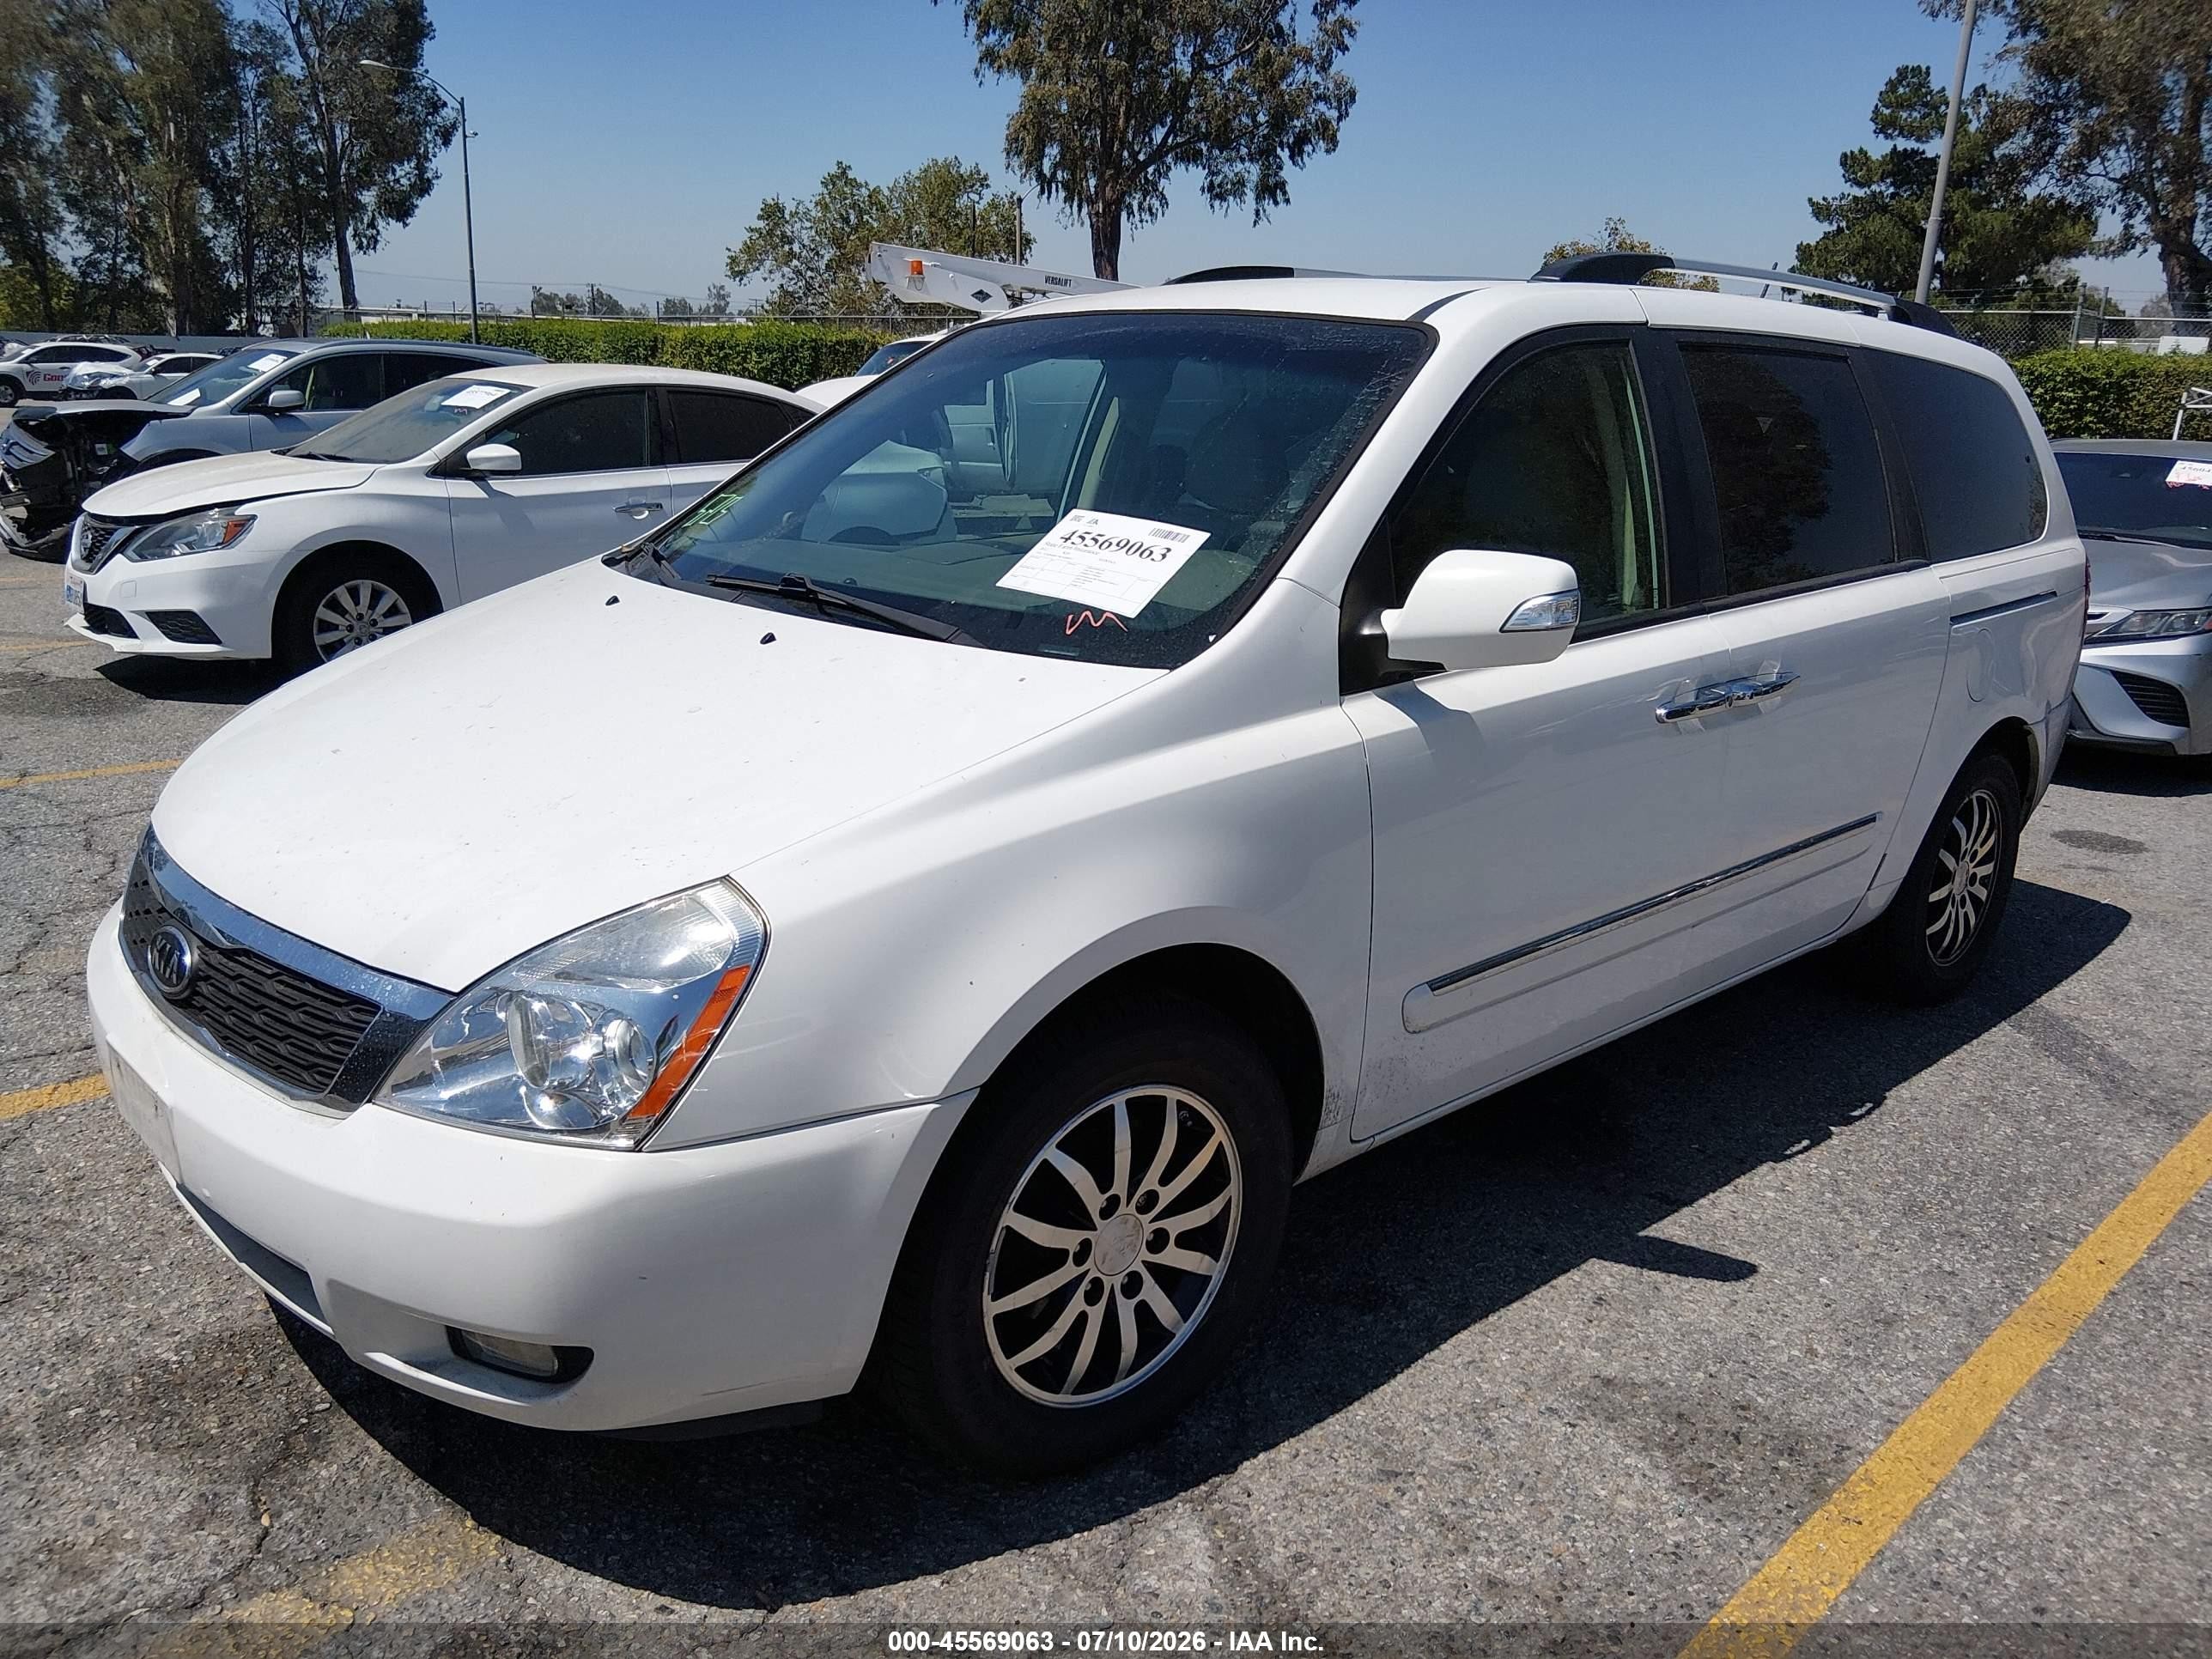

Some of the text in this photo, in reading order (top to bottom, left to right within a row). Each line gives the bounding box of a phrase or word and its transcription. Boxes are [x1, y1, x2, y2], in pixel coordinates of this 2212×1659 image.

[1044, 275, 1072, 288] VERSALIFT
[1060, 530, 1172, 562] 45569063
[151, 934, 180, 985] KIA
